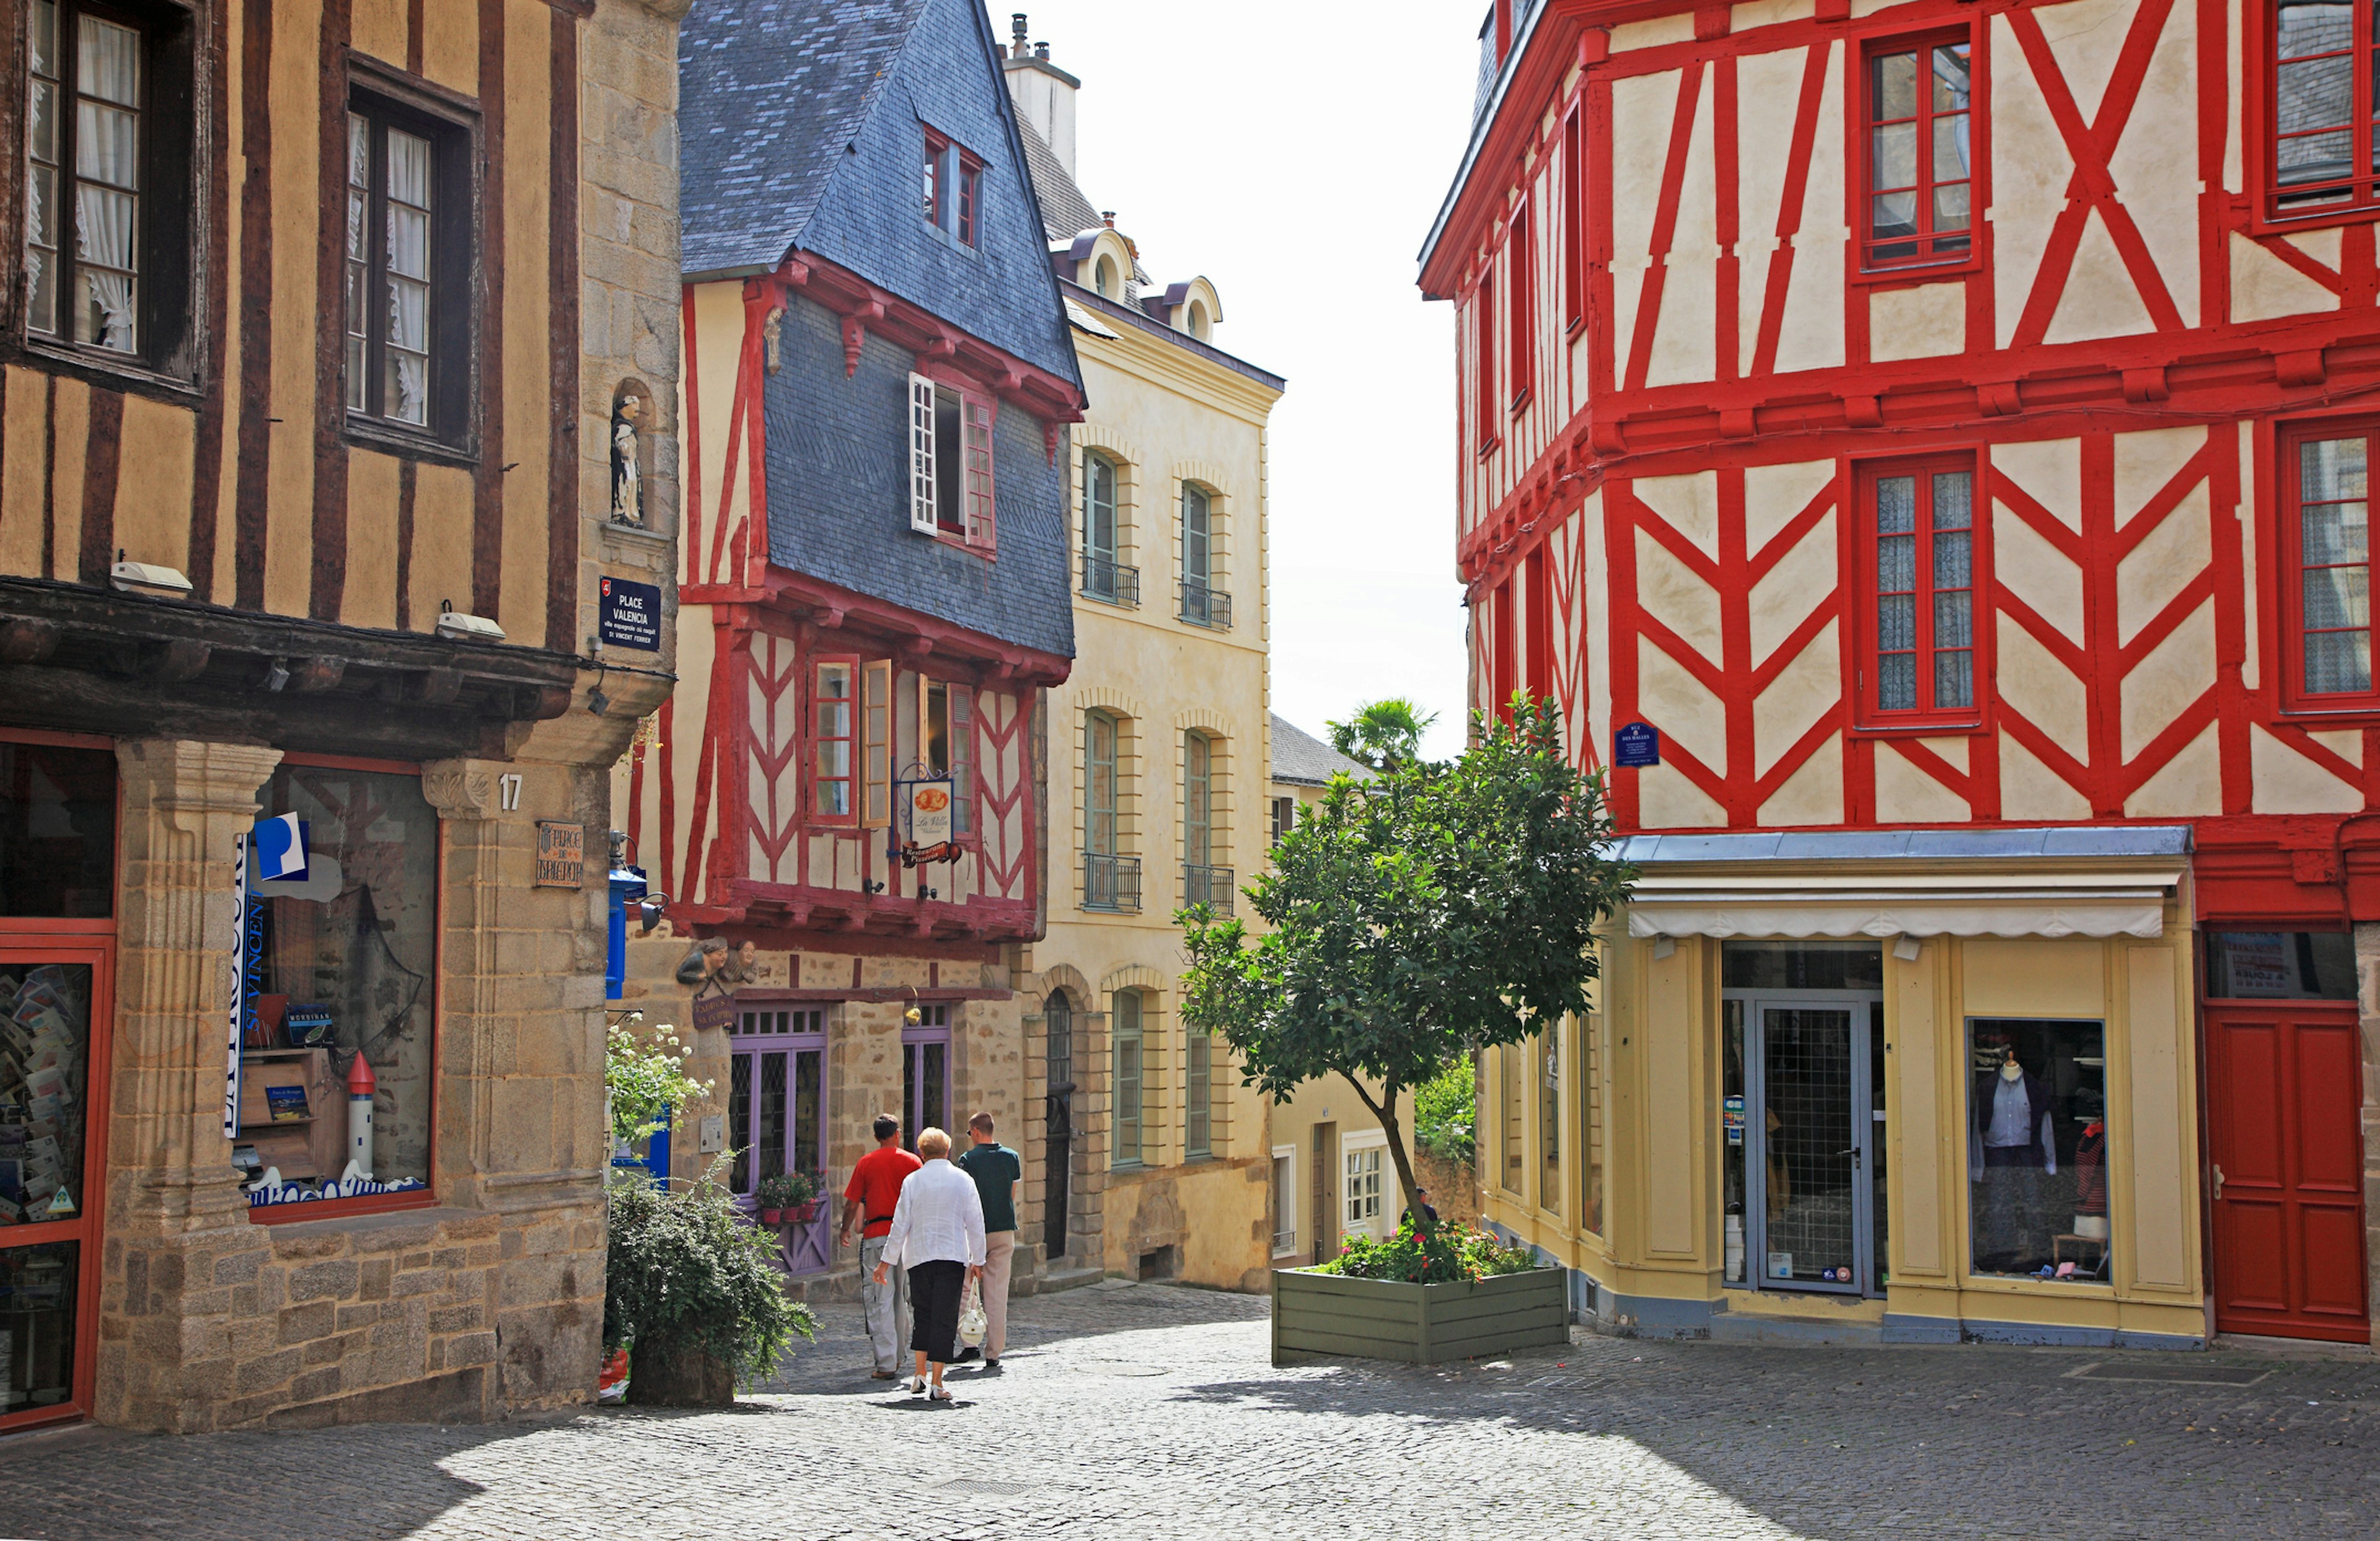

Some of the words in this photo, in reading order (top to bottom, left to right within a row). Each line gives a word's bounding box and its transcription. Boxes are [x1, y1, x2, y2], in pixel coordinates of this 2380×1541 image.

[619, 595, 643, 609] PLACE
[613, 608, 648, 625] VALENCIA
[615, 632, 633, 640] VINCENT
[633, 635, 651, 644] FERRIER
[500, 773, 522, 810] 17
[915, 817, 928, 827] La
[930, 815, 948, 826] Villa
[553, 830, 581, 848] PLACE
[907, 843, 944, 855] Restaurant
[247, 885, 263, 1001] VINCENT
